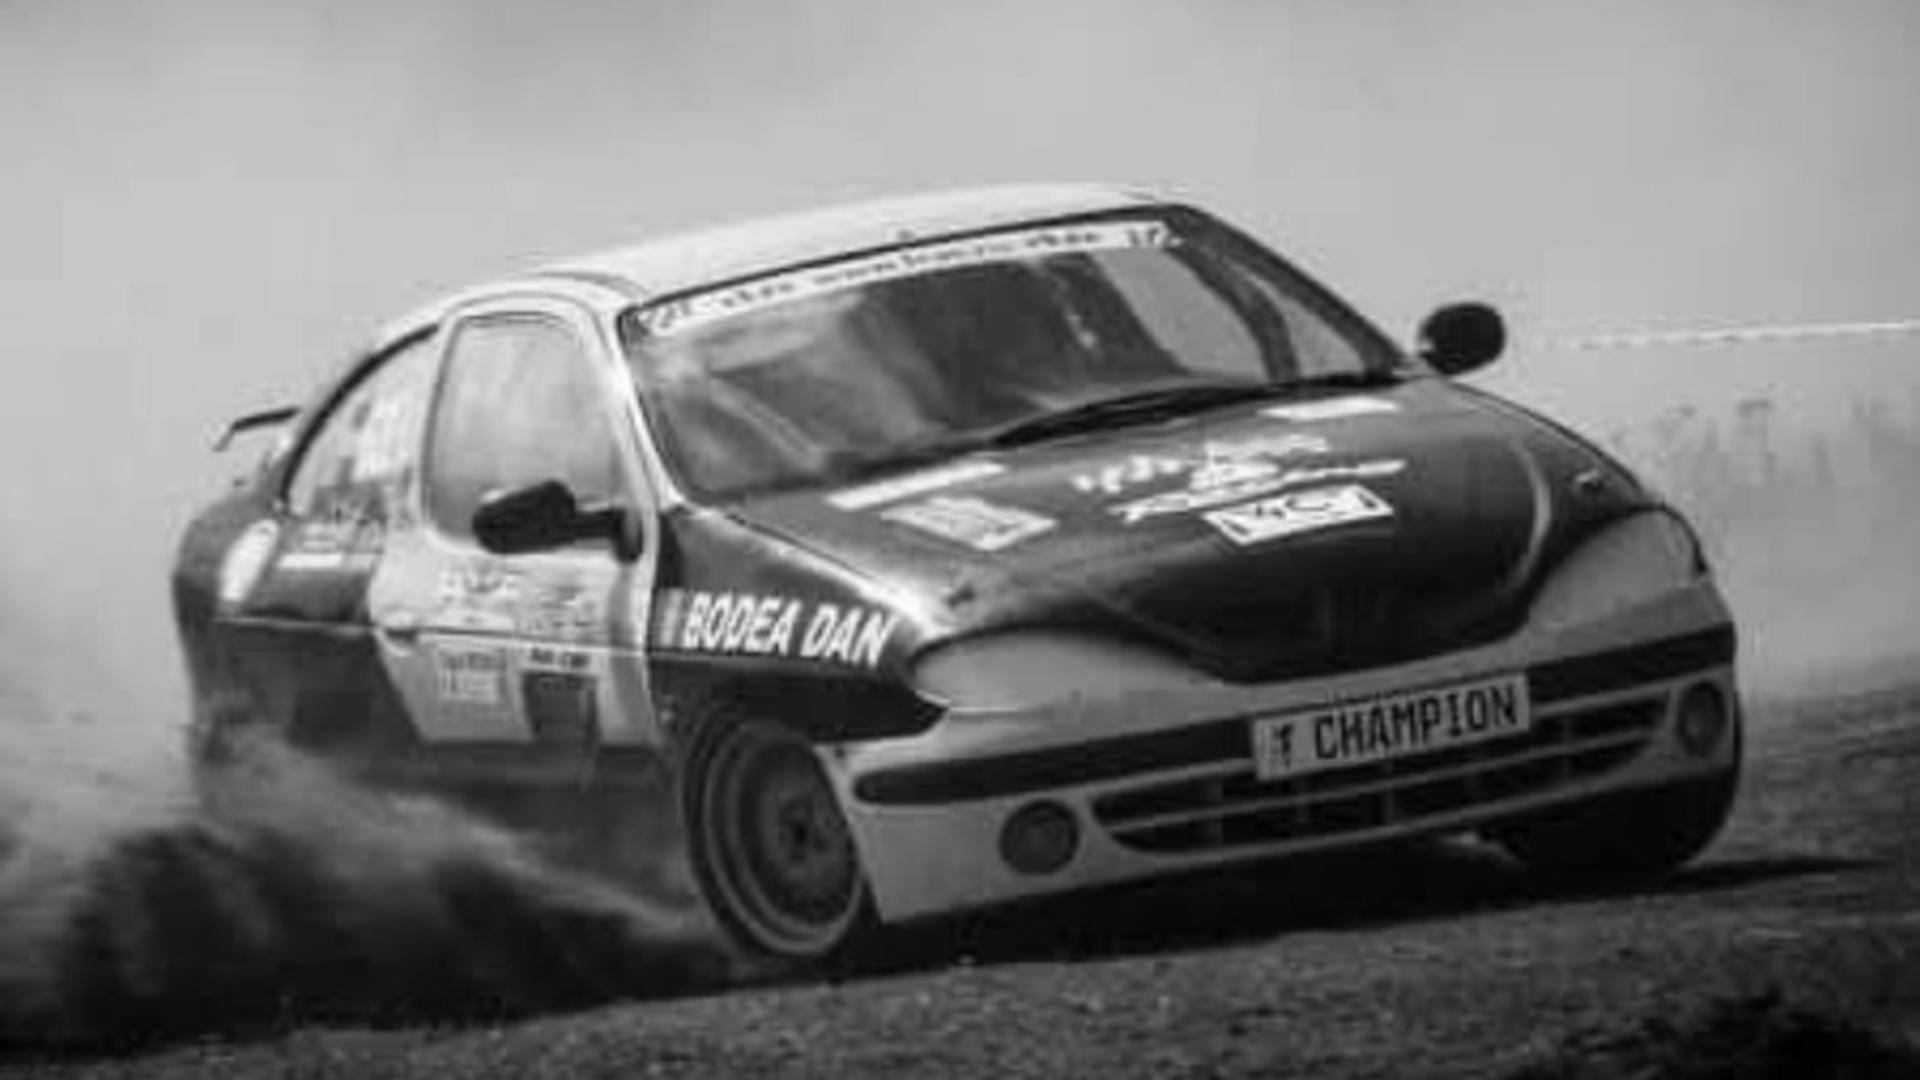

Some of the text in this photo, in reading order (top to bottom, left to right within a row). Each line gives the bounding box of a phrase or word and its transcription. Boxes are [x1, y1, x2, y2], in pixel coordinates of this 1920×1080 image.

[684, 591, 900, 668] BODEA DAN
[1314, 684, 1518, 760] CHAMPION
